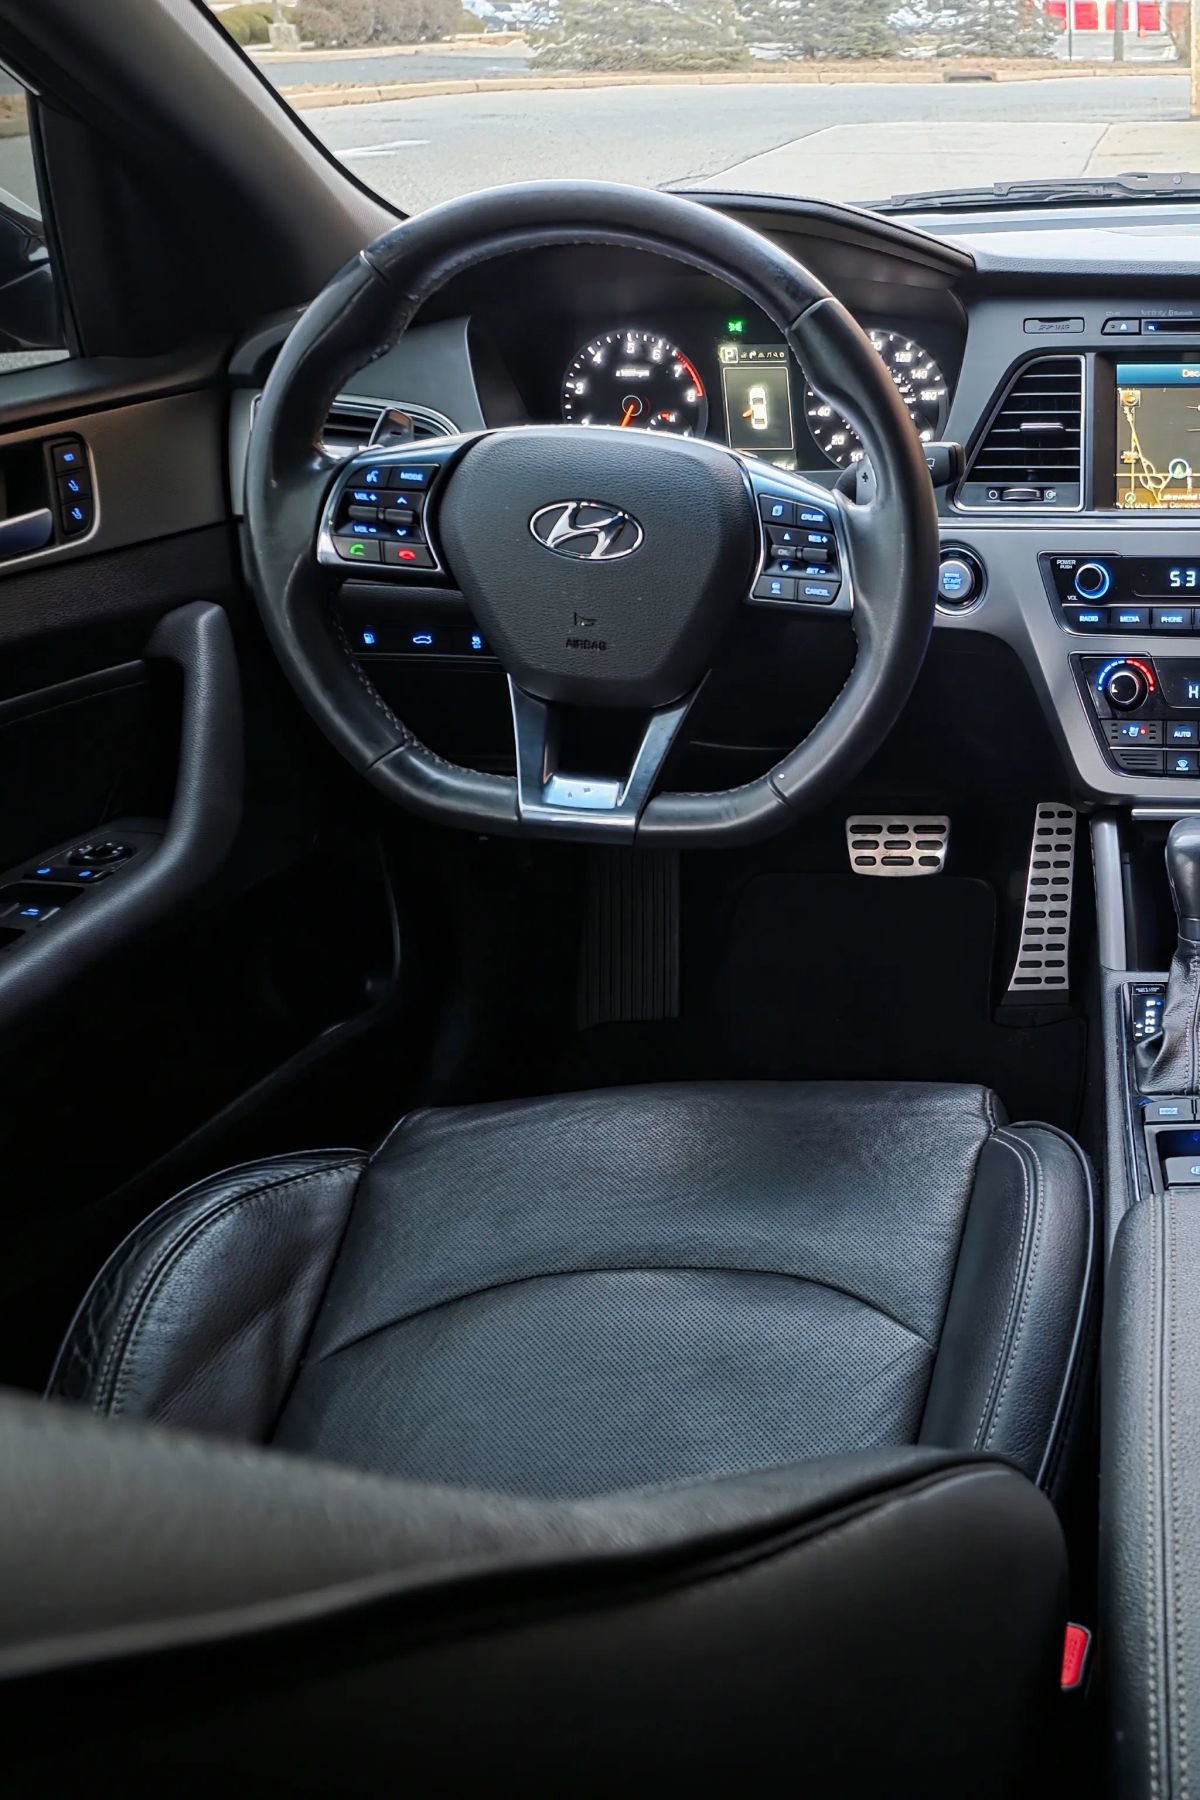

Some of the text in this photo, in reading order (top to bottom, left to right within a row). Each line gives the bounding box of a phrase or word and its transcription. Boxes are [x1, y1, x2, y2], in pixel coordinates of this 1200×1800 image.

[627, 342, 635, 354] 5
[593, 352, 602, 364] 4
[652, 349, 661, 361] 6
[895, 351, 913, 363] 120
[674, 365, 683, 378] 7
[912, 369, 928, 380] 140
[574, 382, 584, 395] 3
[687, 390, 697, 403] 8
[818, 406, 831, 417] 40
[832, 434, 845, 445] 20
[400, 472, 424, 482] MODE
[801, 513, 824, 522] CRUISE
[804, 587, 830, 597] CANCEL
[1119, 615, 1141, 623] MEDIA
[1173, 730, 1192, 738] AUTO
